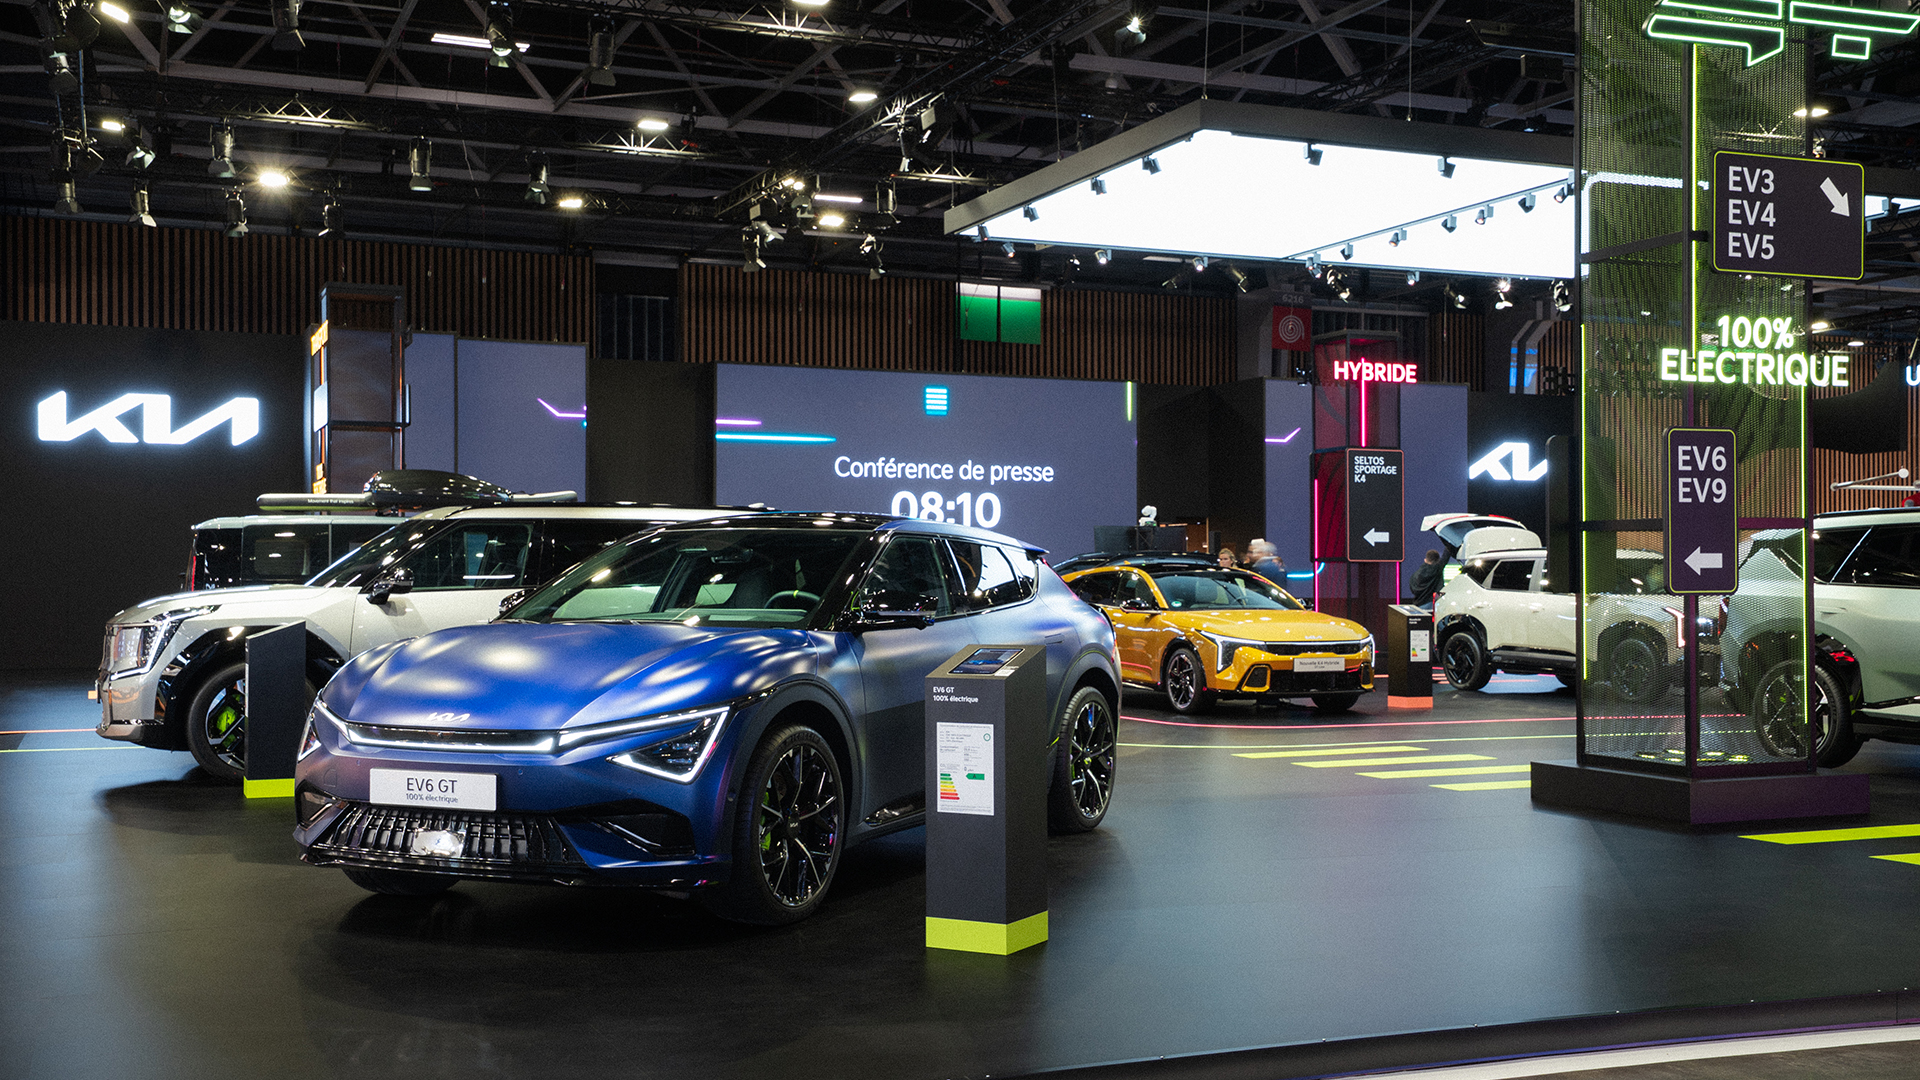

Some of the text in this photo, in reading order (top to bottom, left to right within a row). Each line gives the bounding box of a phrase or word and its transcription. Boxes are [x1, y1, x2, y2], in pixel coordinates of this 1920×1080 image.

[1728, 165, 1775, 195] EV3
[1728, 198, 1776, 228] EV4
[1728, 231, 1775, 261] EV5
[1282, 294, 1304, 304] 6216
[1717, 315, 1795, 350] 100%
[1334, 360, 1417, 383] HYBRIDE
[1660, 347, 1850, 387] ELECTRIQUE
[38, 391, 259, 446] KIA
[834, 455, 1055, 486] Conférence de presse
[1354, 455, 1385, 466] SELTOS
[1354, 464, 1397, 476] SPORTAGE
[1678, 445, 1727, 472] EV6
[1354, 475, 1367, 484] K4
[1678, 477, 1727, 504] EV9
[890, 490, 1002, 529] 08:10
[932, 686, 955, 694] EV6 GT
[932, 694, 979, 704] 100% électrique
[406, 777, 458, 794] EV6 GT
[406, 793, 459, 804] 100% électrique
